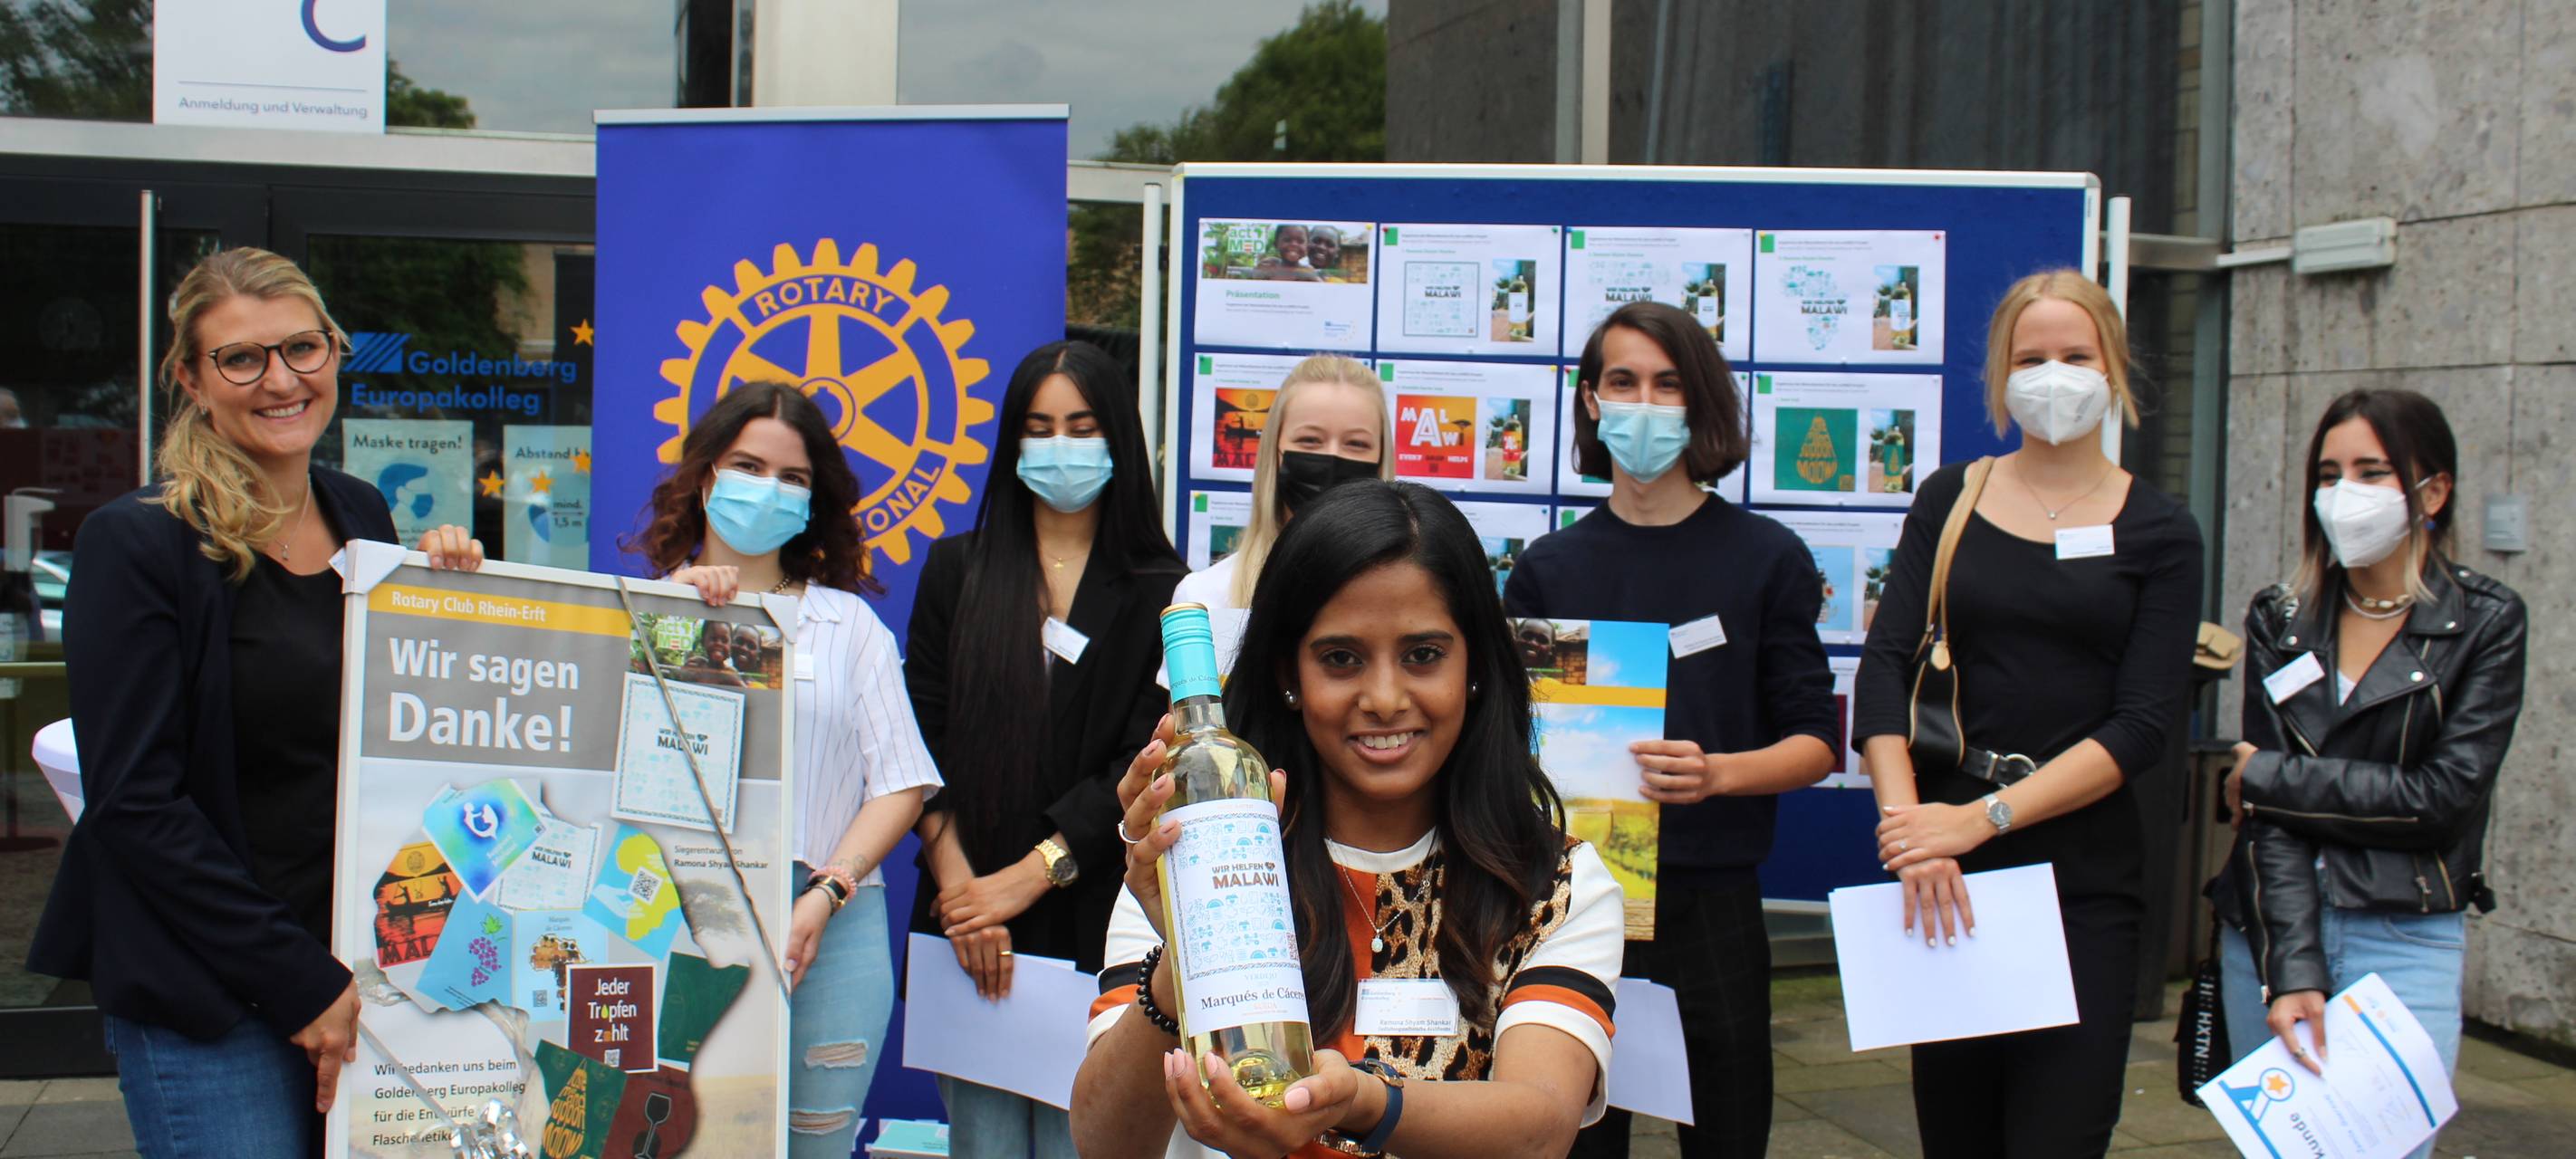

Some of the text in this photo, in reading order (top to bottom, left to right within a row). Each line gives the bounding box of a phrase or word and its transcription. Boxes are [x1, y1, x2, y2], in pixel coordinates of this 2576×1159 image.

[178, 97, 368, 119] Anmeldung und Verwaltung
[754, 276, 896, 318] ROTARY
[1226, 290, 1280, 299] Präsentation
[1425, 290, 1461, 298] MALAWI
[409, 350, 577, 384] Goldenberg
[351, 383, 541, 416] Europakolleg
[353, 435, 462, 454] Maske tragen!
[514, 447, 571, 459] Abstand
[553, 501, 582, 509] mind.
[554, 517, 570, 528] 1,5
[391, 591, 546, 622] Rotary Club Rhein-Erft
[389, 637, 580, 695] Wir sagen
[389, 691, 572, 753] Danke!
[658, 735, 708, 755] MALWI
[532, 851, 572, 868] MALAWI
[674, 846, 725, 855] Siegerentwur
[674, 859, 706, 867] Ramona
[708, 859, 733, 869] Shya
[1212, 863, 1264, 874] WIR HELFEN
[1212, 872, 1279, 889] MALAWI
[594, 977, 630, 997] Jeder
[1201, 989, 1258, 1010] Marqués
[1262, 988, 1274, 999] de
[2194, 1011, 2213, 1058] HXTN
[463, 1061, 485, 1072] uns
[487, 1058, 516, 1070] beim
[375, 1081, 526, 1099] Goldeerg Europakolleg
[374, 1107, 476, 1123] für die Enürfe
